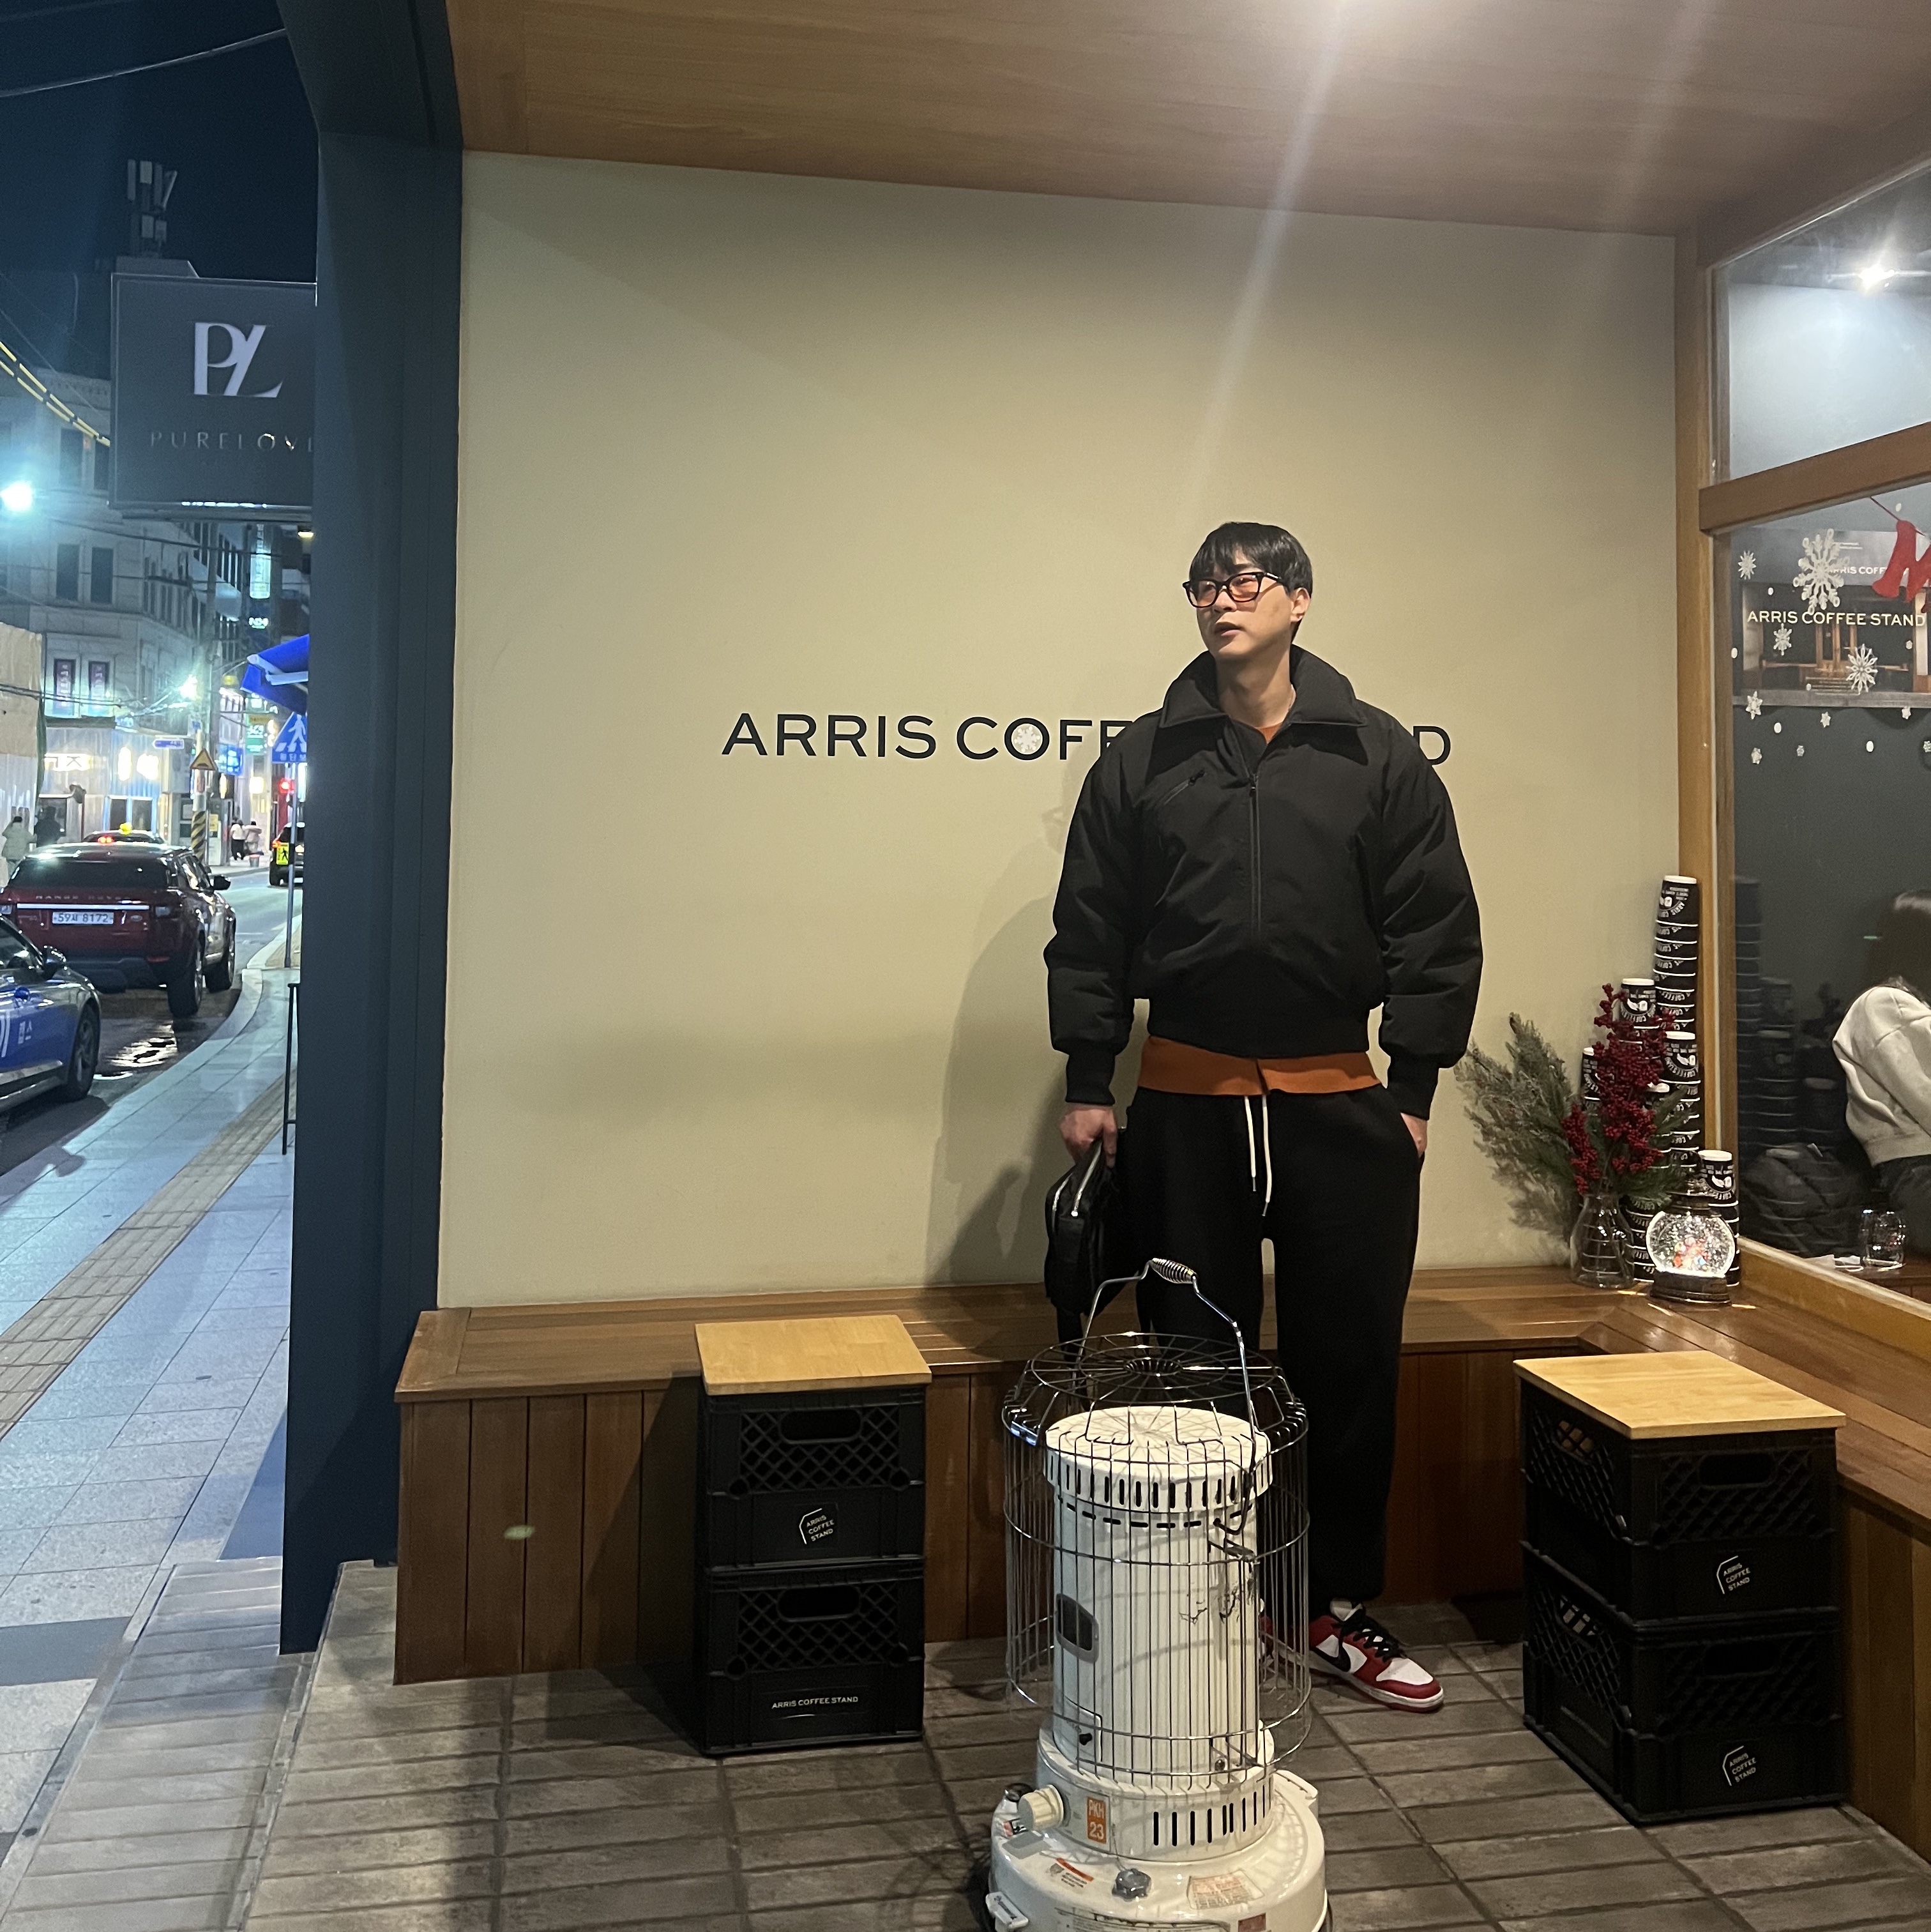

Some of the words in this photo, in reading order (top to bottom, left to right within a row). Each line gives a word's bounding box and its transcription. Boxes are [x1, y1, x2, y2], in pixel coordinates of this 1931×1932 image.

[1747, 610, 1798, 624] ARRIS
[1801, 611, 1867, 625] COFFEE
[1870, 613, 1926, 627] STAND
[722, 713, 936, 759] ARRIS
[956, 716, 1133, 760] COFF
[82, 913, 109, 923] 8172
[806, 1515, 827, 1527] ARRIS
[808, 1519, 835, 1534] COFFEE
[810, 1528, 833, 1542] STAND
[771, 1700, 797, 1709] ARRIS
[798, 1697, 830, 1706] COFFEE
[1089, 1821, 1104, 1840] 23
